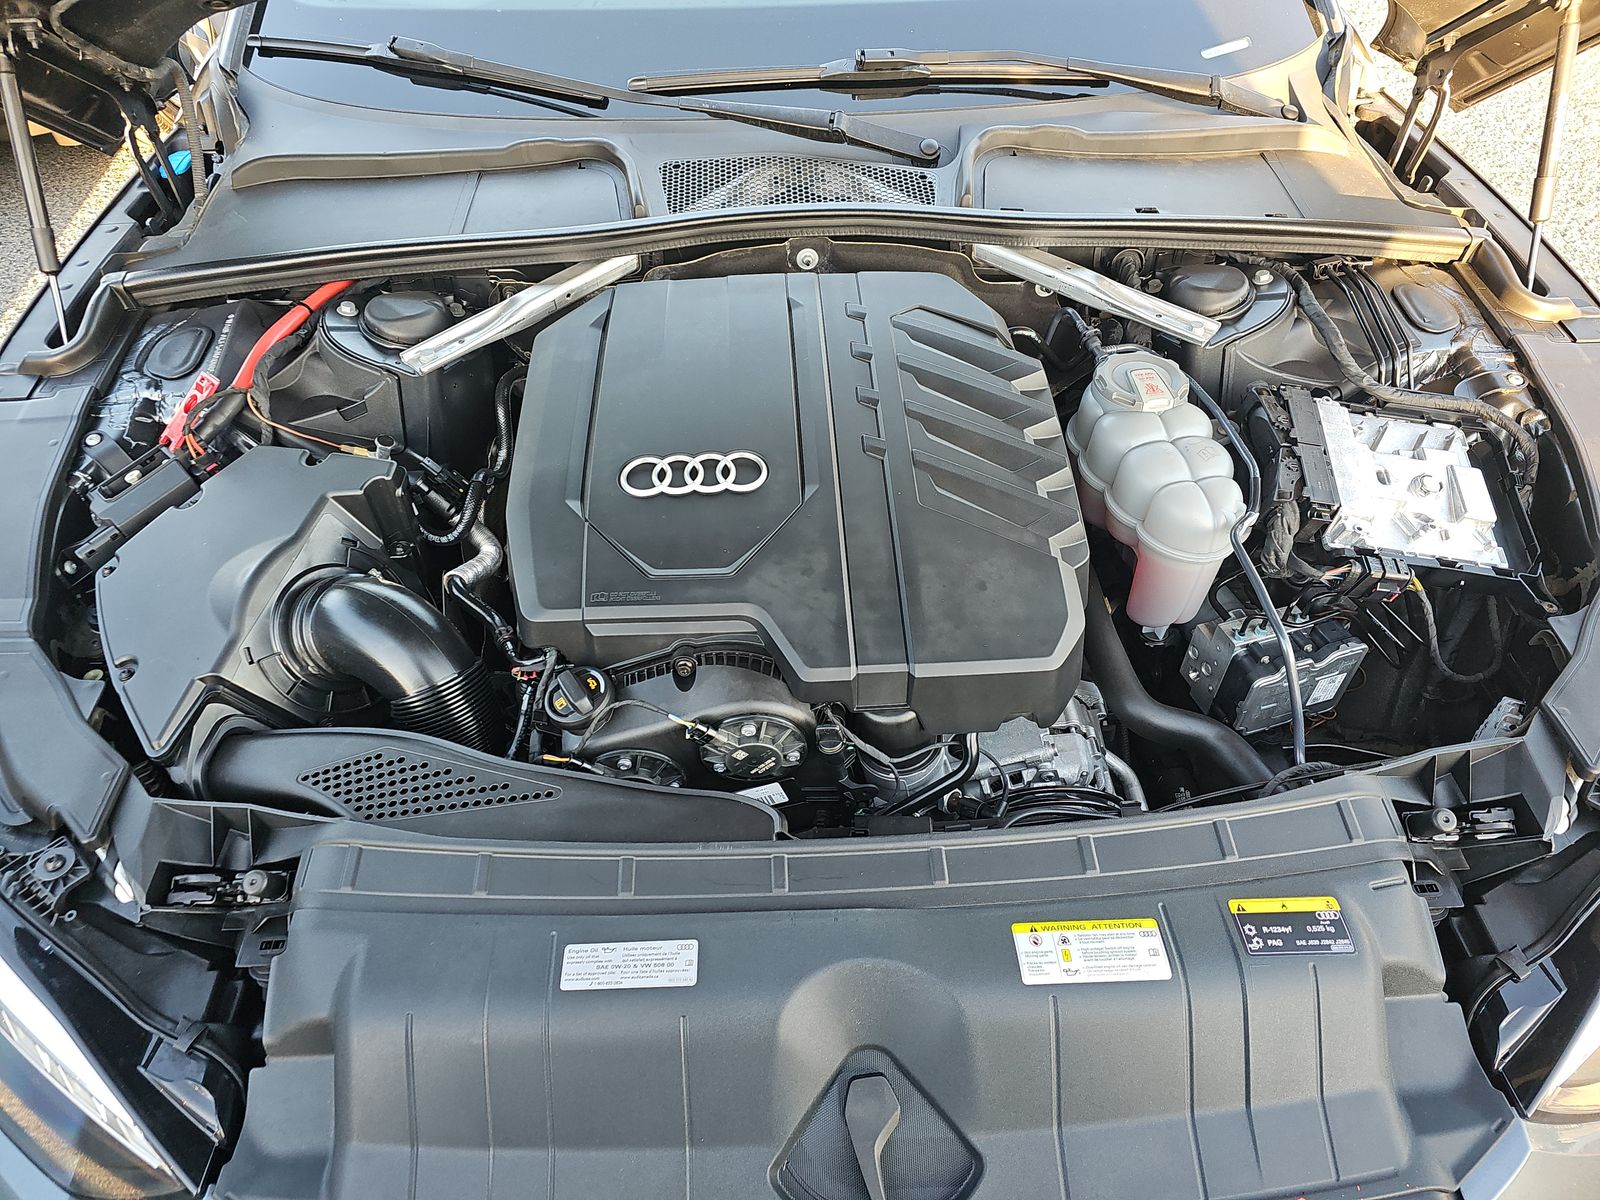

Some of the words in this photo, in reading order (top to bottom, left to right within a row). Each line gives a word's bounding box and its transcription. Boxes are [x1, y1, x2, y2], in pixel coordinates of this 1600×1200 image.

[1041, 924, 1087, 932] WARNING
[1091, 922, 1142, 930] ATTENTION
[1262, 925, 1292, 934] R-1234yf
[1326, 925, 1336, 933] kg
[1267, 939, 1284, 947] PAG
